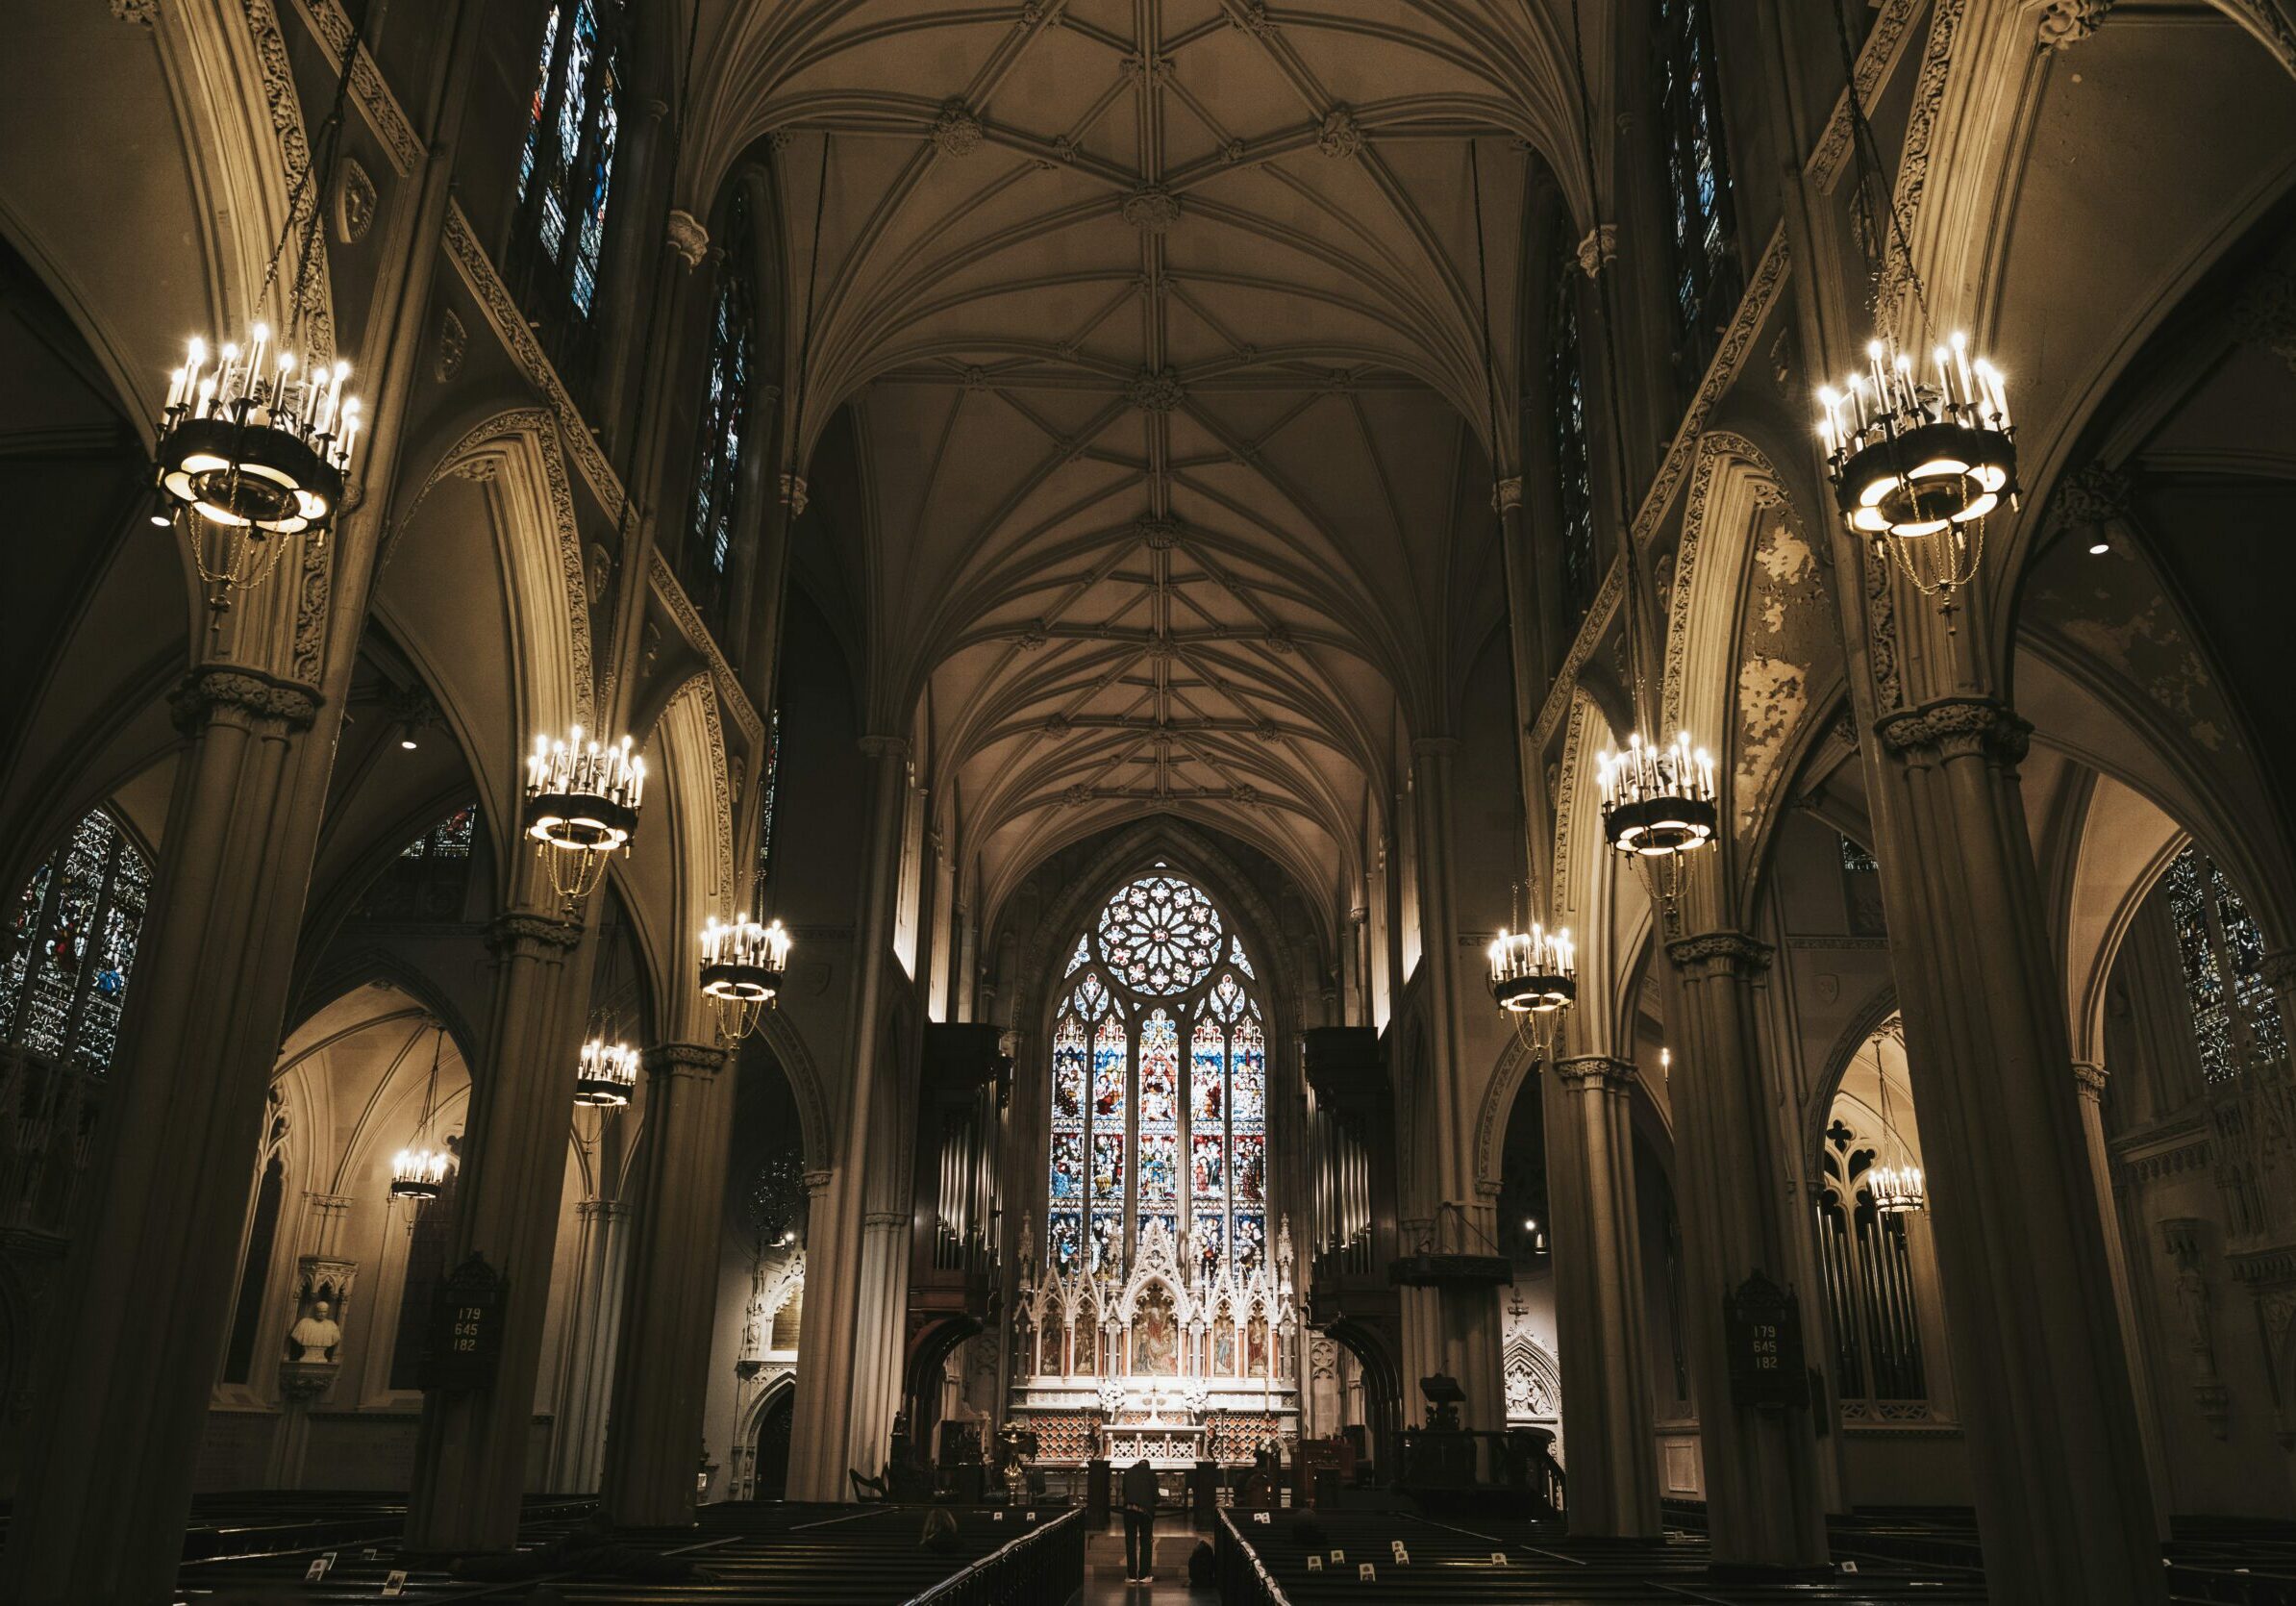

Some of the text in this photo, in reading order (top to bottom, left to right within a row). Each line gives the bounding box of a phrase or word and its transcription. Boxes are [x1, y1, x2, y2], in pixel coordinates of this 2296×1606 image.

[459, 1307, 482, 1320] 179
[454, 1322, 479, 1336] 645
[1753, 1325, 1776, 1338] 179
[453, 1338, 476, 1351] 182
[1753, 1341, 1777, 1353] 645
[1756, 1356, 1778, 1369] 182
